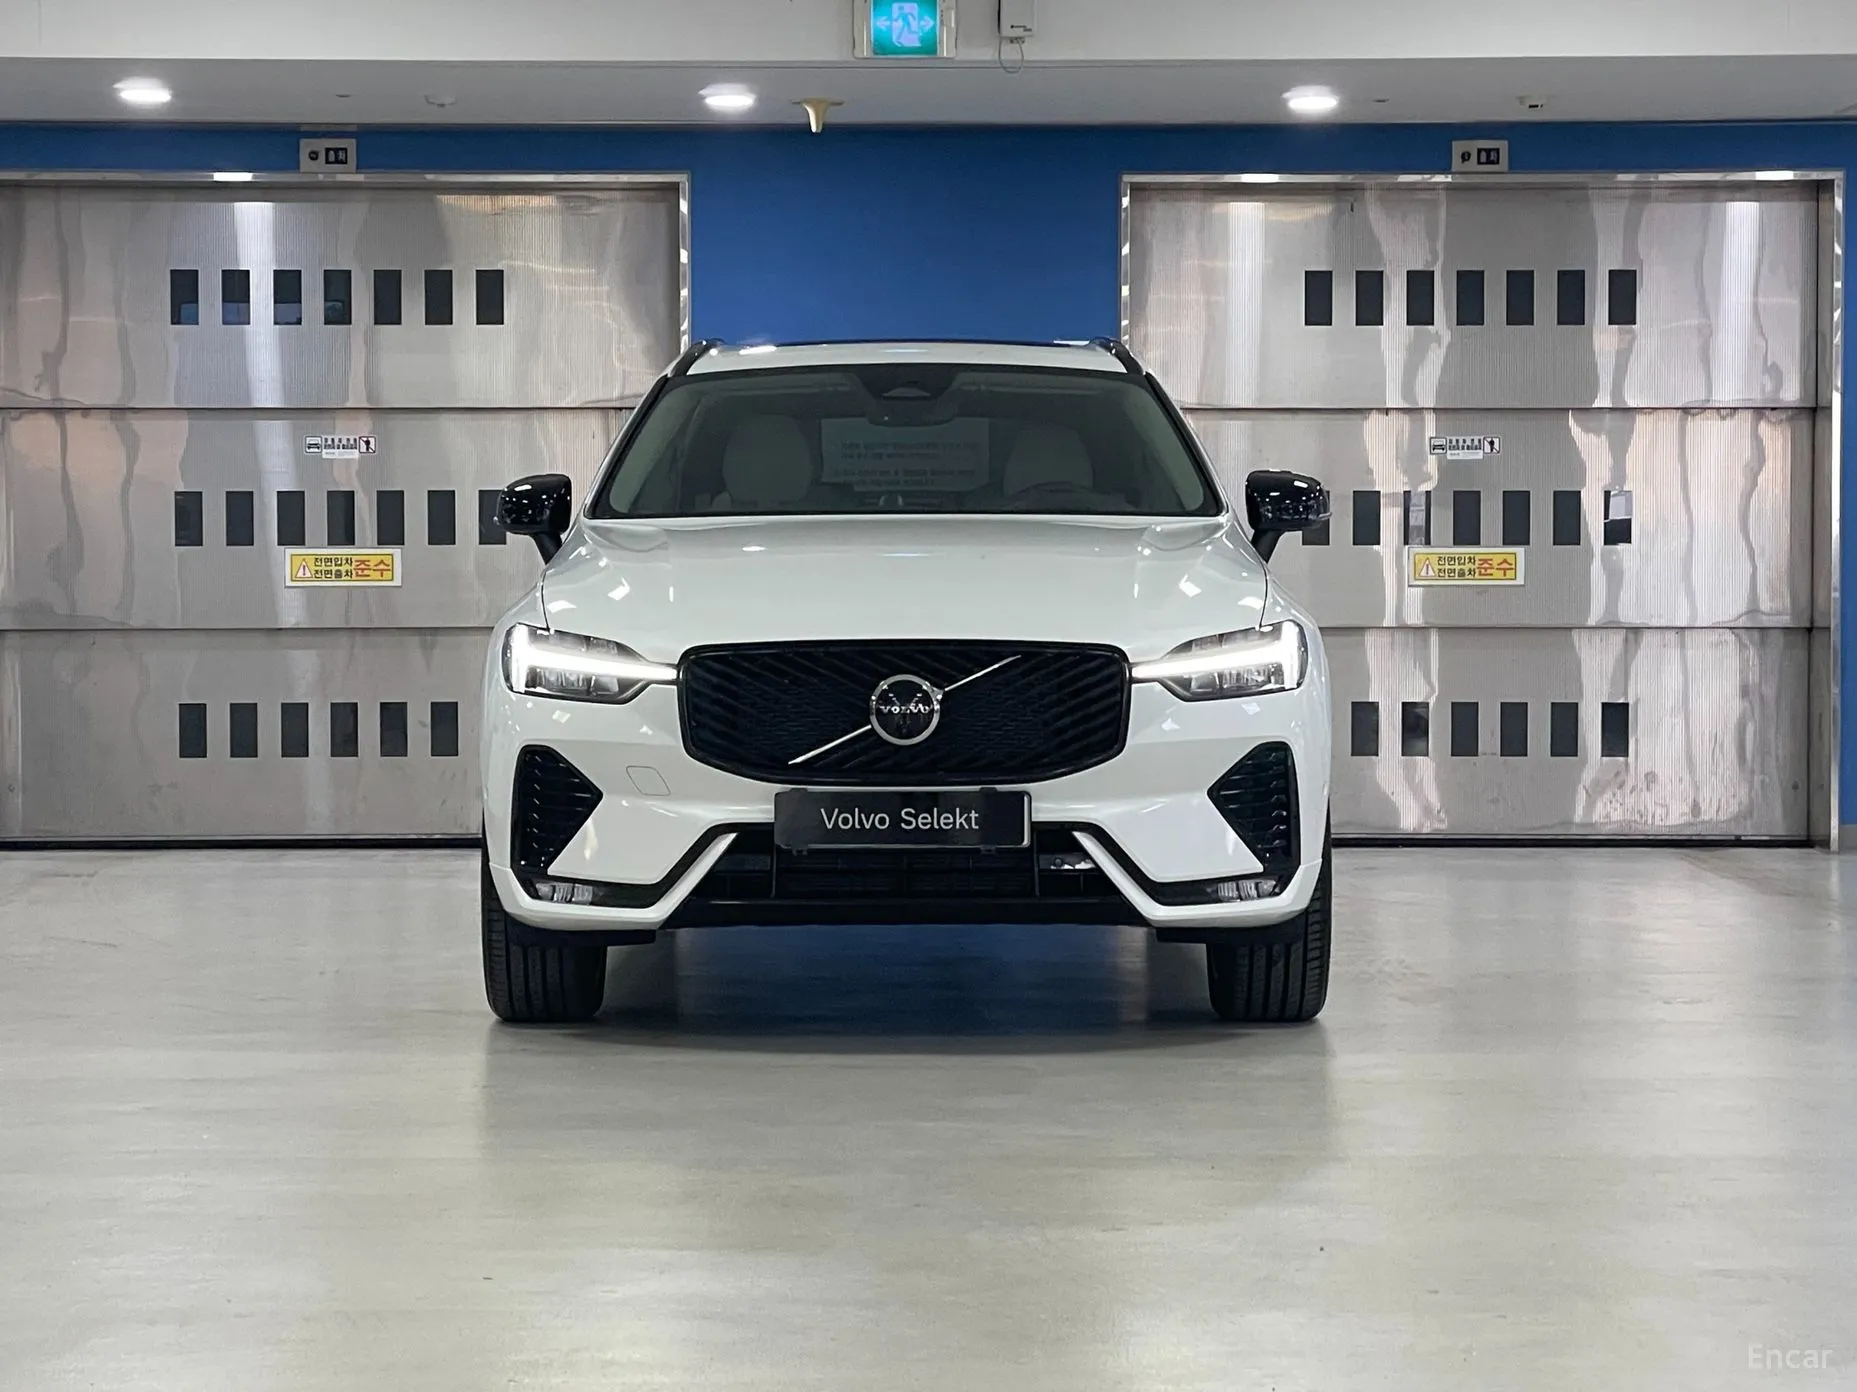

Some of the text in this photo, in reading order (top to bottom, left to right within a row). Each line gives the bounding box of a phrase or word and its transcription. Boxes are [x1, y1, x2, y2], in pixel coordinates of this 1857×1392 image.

[313, 557, 353, 567] 전면입차
[353, 559, 391, 578] 준수
[1437, 556, 1476, 566] 전면입차
[1476, 558, 1514, 577] 준수
[820, 807, 979, 830] Volvo Selekt
